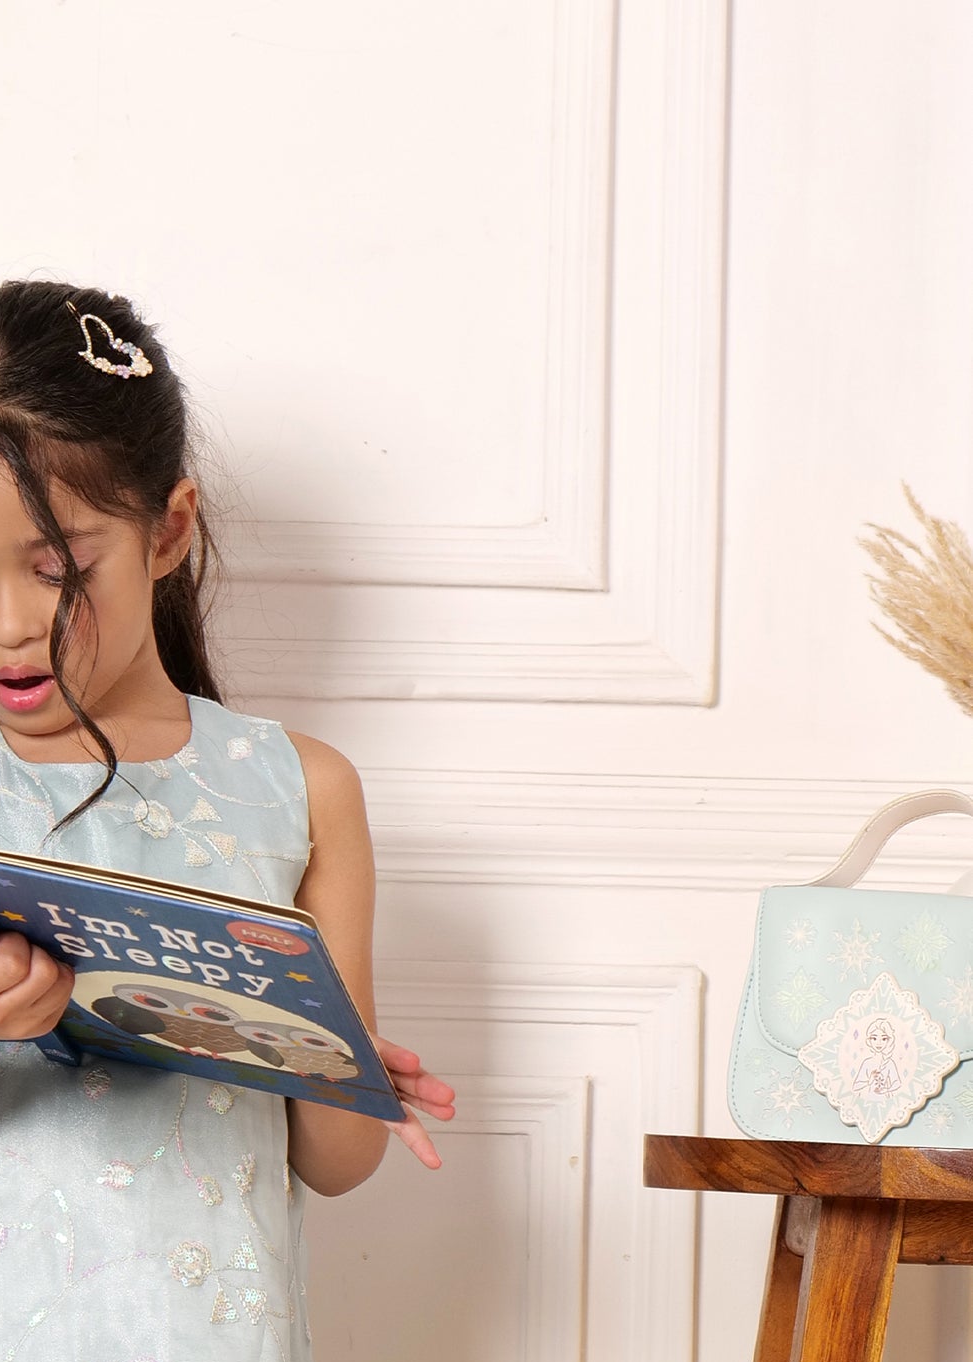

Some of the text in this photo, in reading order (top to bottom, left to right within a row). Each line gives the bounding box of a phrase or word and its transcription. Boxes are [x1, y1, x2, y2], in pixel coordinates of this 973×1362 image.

[37, 902, 265, 966] I'm Not
[53, 933, 274, 997] Sleepy
